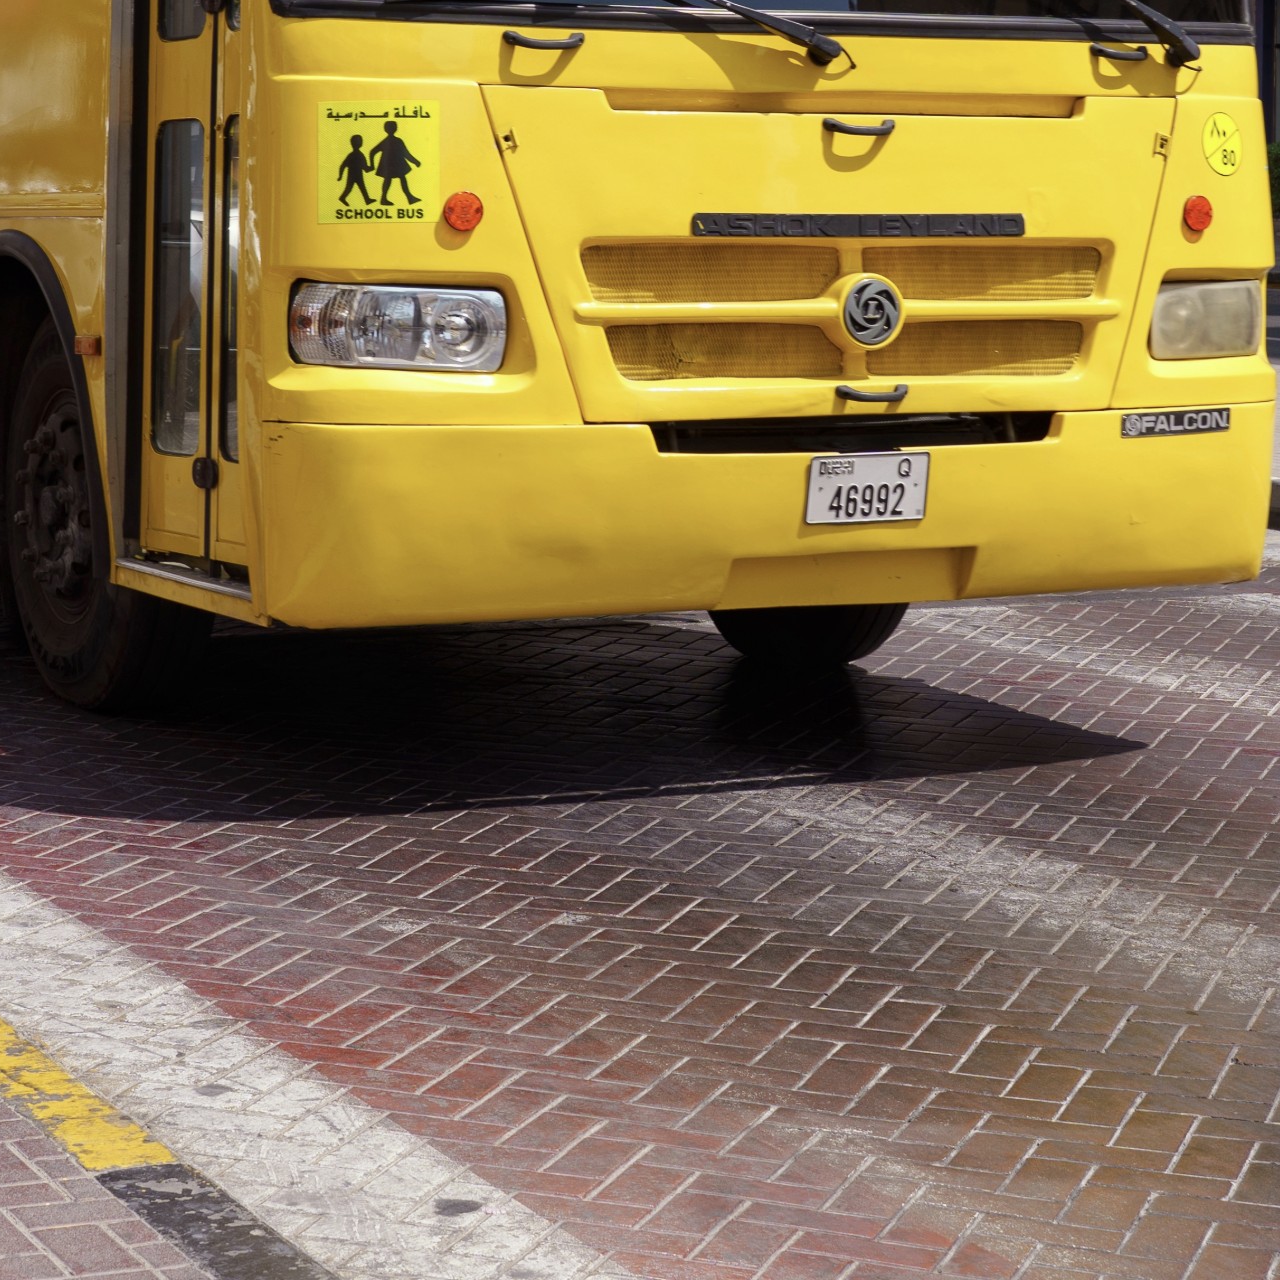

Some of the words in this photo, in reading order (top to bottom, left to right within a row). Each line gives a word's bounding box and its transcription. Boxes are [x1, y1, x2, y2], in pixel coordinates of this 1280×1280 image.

[326, 108, 389, 121] مدرسية
[394, 106, 431, 119] حافلة
[1222, 148, 1236, 166] 80
[335, 208, 393, 220] SCHOOL
[396, 207, 424, 220] BUS
[702, 215, 833, 237] ASHOK
[858, 214, 1023, 237] LEYLAND
[1141, 411, 1229, 433] FALCON
[898, 457, 912, 477] Q
[828, 483, 905, 517] 46992
